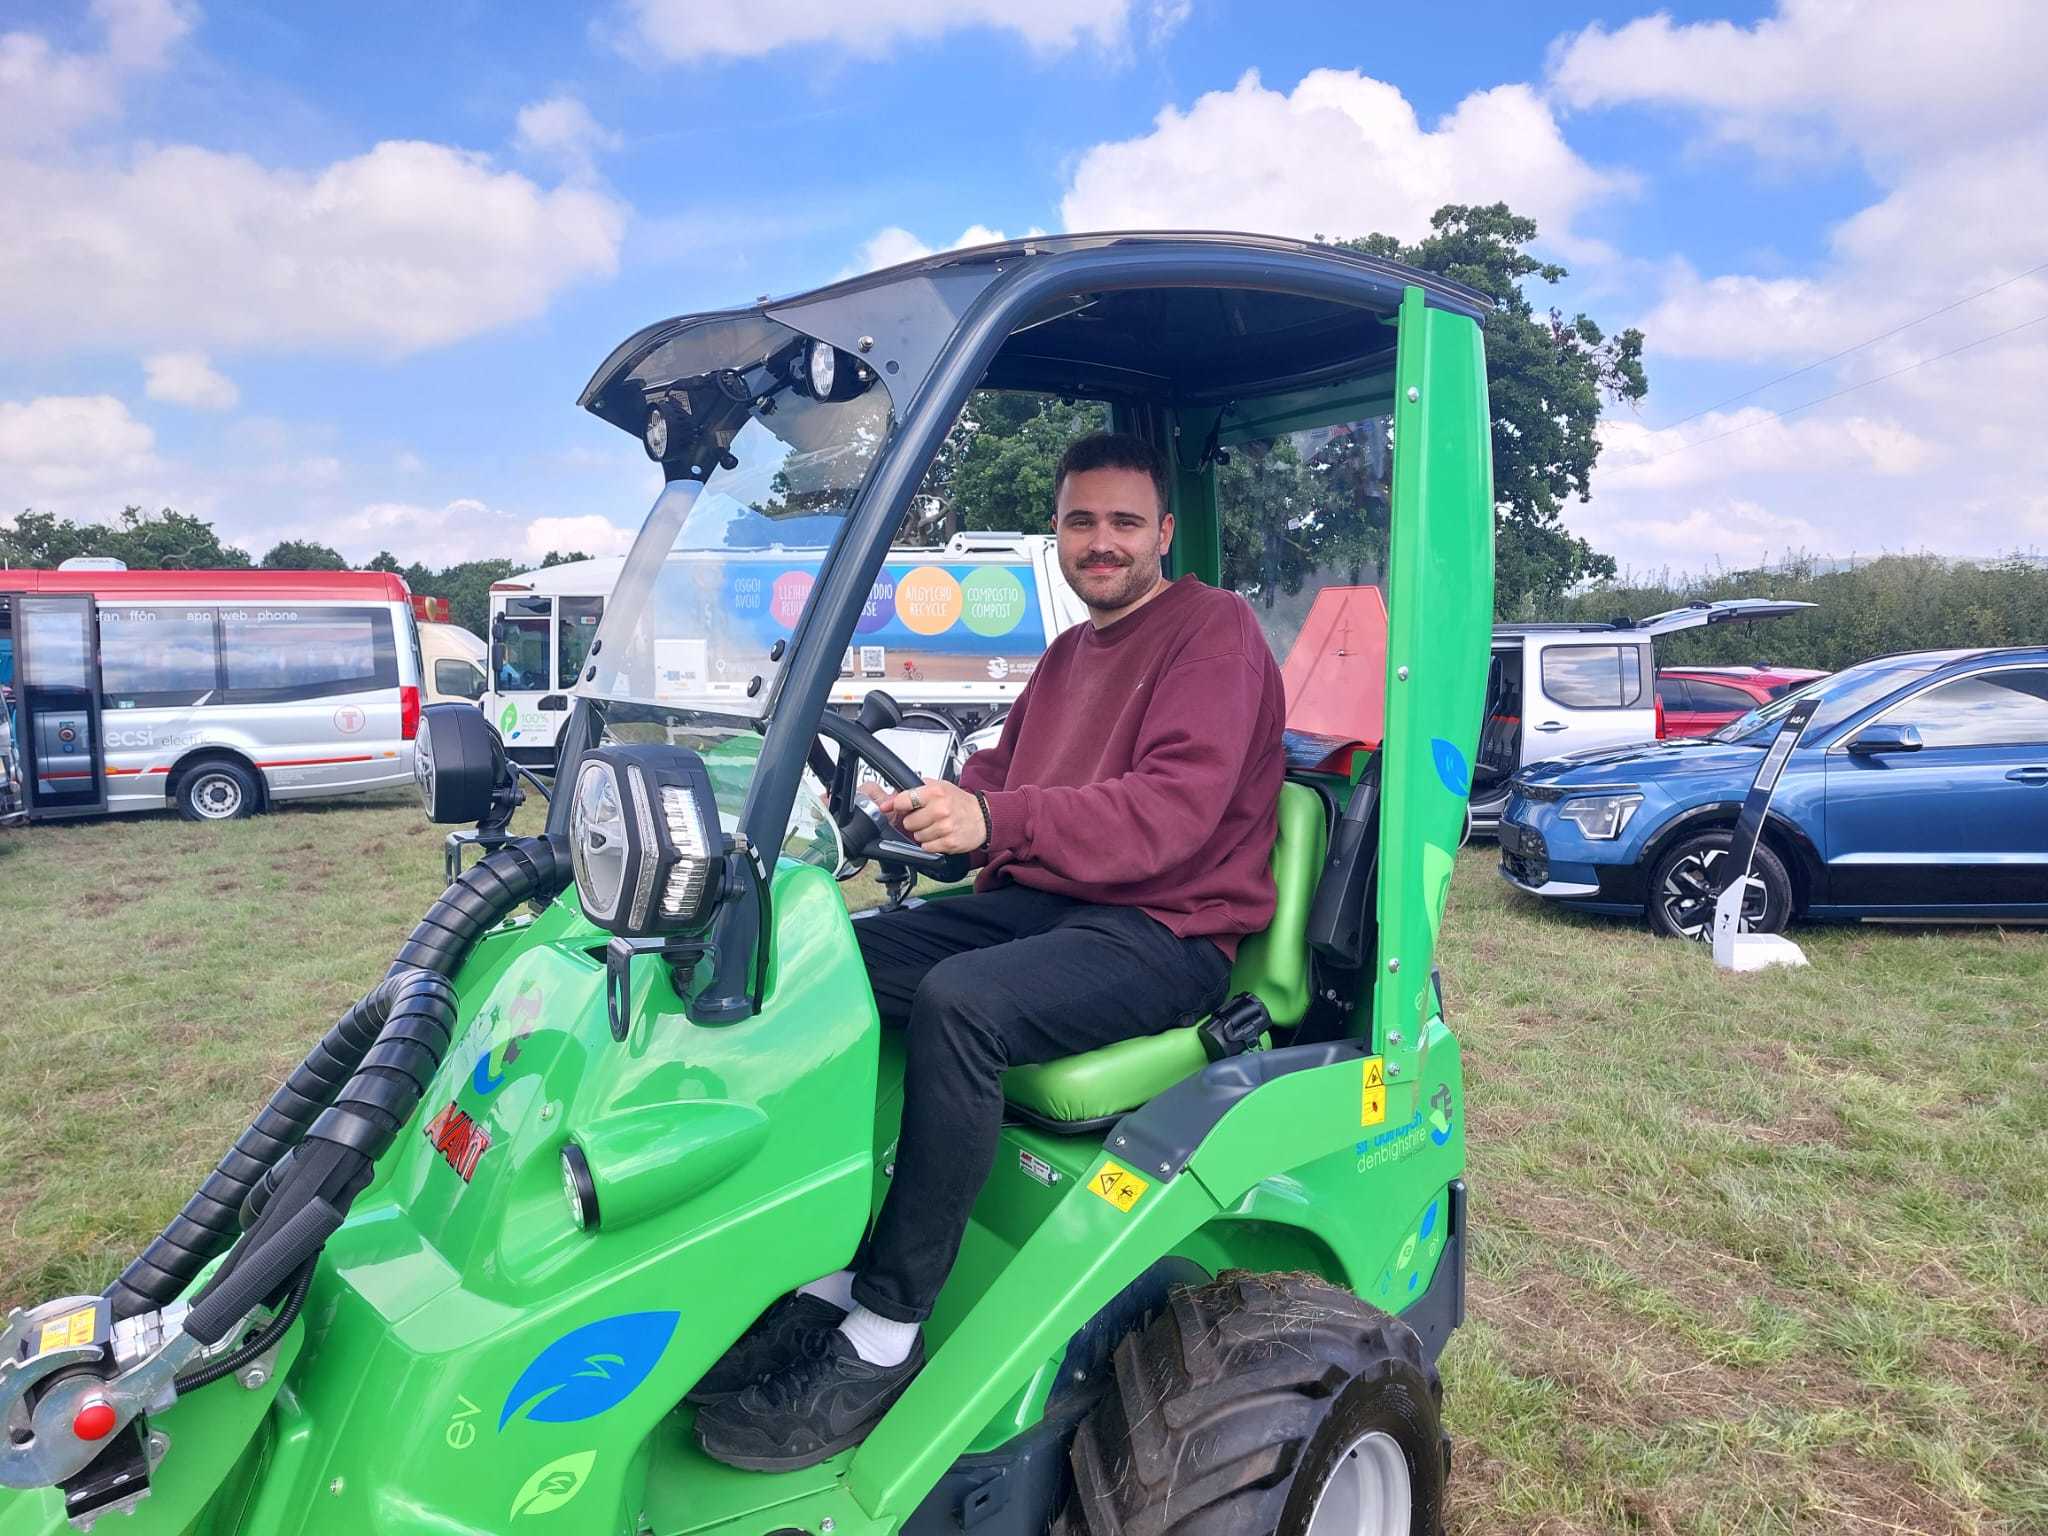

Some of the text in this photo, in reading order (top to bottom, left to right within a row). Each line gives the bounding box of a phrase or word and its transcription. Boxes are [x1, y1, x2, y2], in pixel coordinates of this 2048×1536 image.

[186, 610, 298, 624] app web phone
[971, 603, 1011, 618] COMPOST
[1357, 1127, 1426, 1174] denbighshire
[446, 1393, 482, 1450] ev
